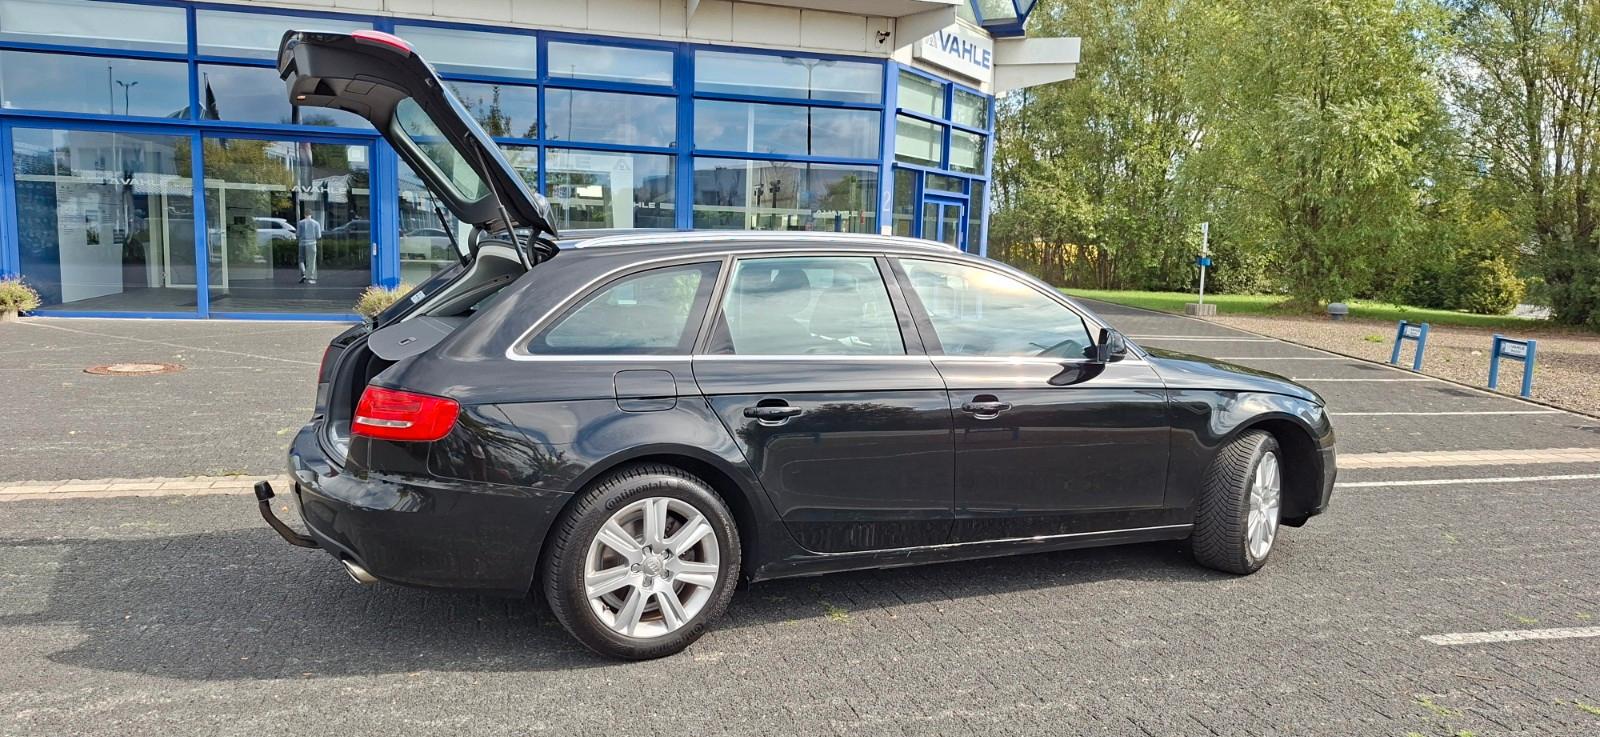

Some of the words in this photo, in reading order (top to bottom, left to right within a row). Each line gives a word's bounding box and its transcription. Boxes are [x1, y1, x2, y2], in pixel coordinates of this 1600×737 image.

[939, 30, 991, 70] VAHLE
[301, 185, 347, 195] VAHLE
[883, 190, 892, 212] 2
[632, 201, 656, 209] HLE
[605, 480, 662, 510] Continental
